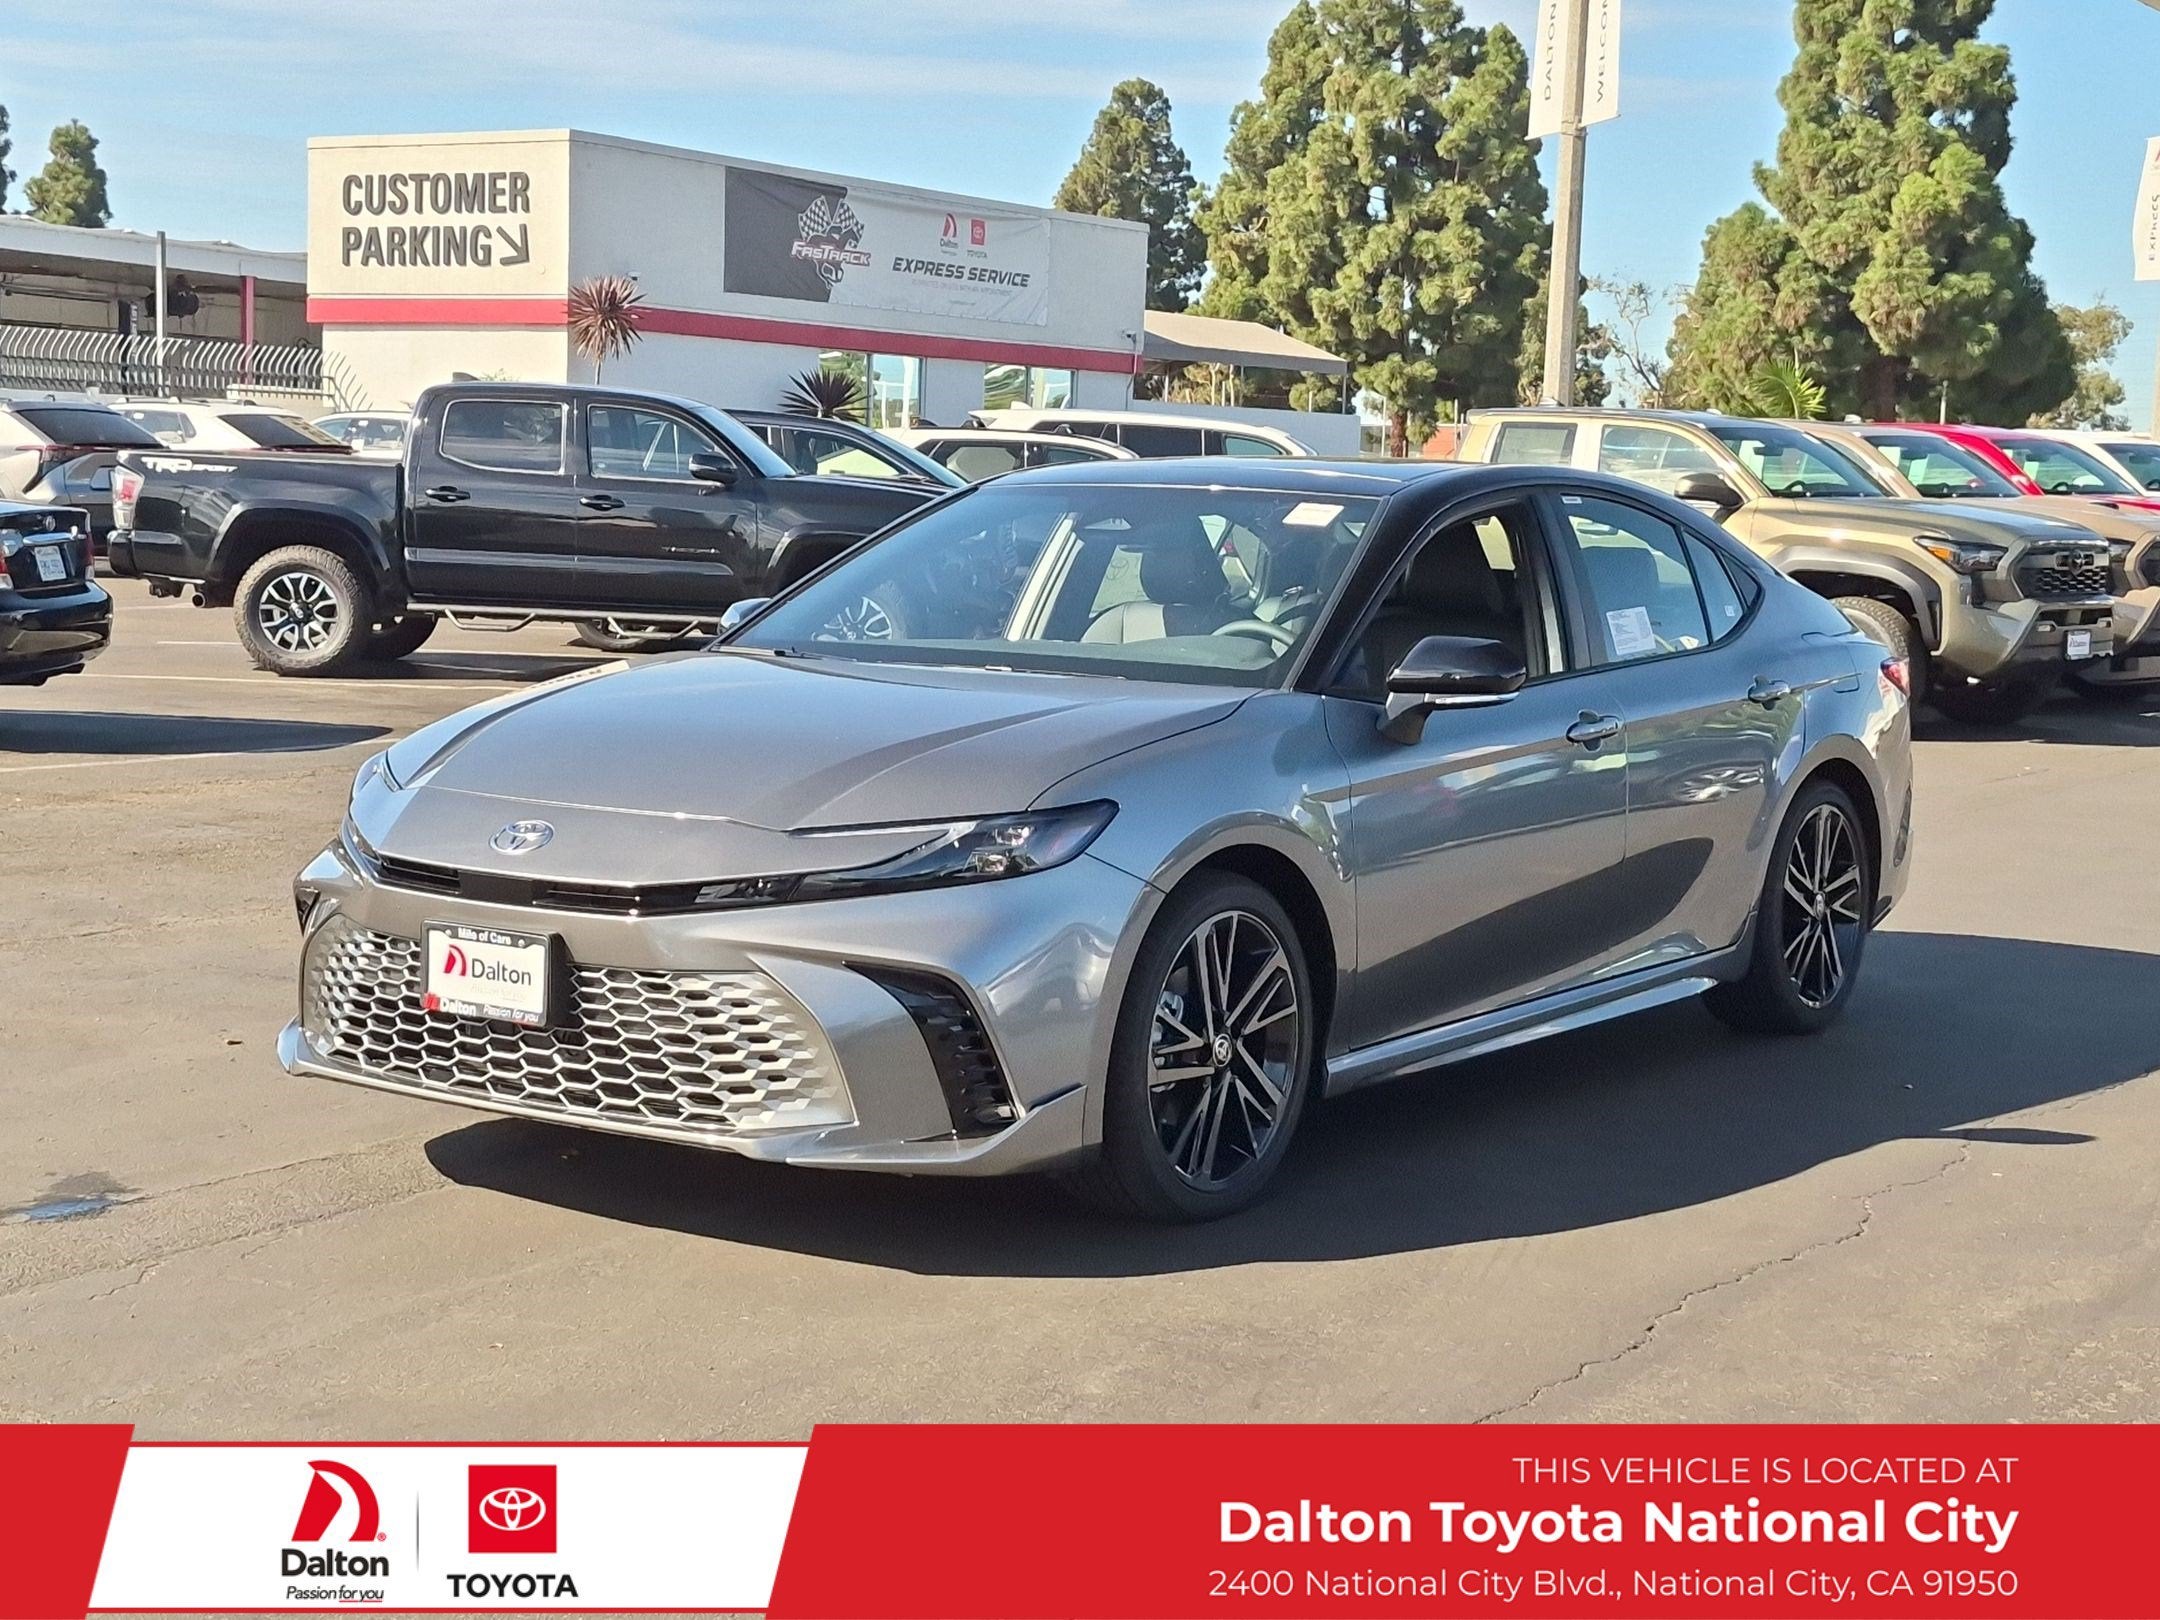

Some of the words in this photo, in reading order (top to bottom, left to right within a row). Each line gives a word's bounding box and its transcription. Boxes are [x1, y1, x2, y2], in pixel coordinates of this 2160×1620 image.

[1544, 3, 1557, 101] DALTON
[342, 171, 531, 216] CUSTOMER
[341, 224, 493, 267] PARKING
[892, 257, 965, 279] EXPRESS
[967, 266, 1031, 288] SERVICE
[457, 927, 477, 940] Mile
[478, 931, 489, 941] of
[490, 932, 512, 945] Cars
[471, 957, 532, 986] Dalton
[440, 997, 477, 1017] Dalton
[483, 1003, 511, 1018] Passion
[512, 1008, 525, 1019] for
[524, 1012, 539, 1023] you
